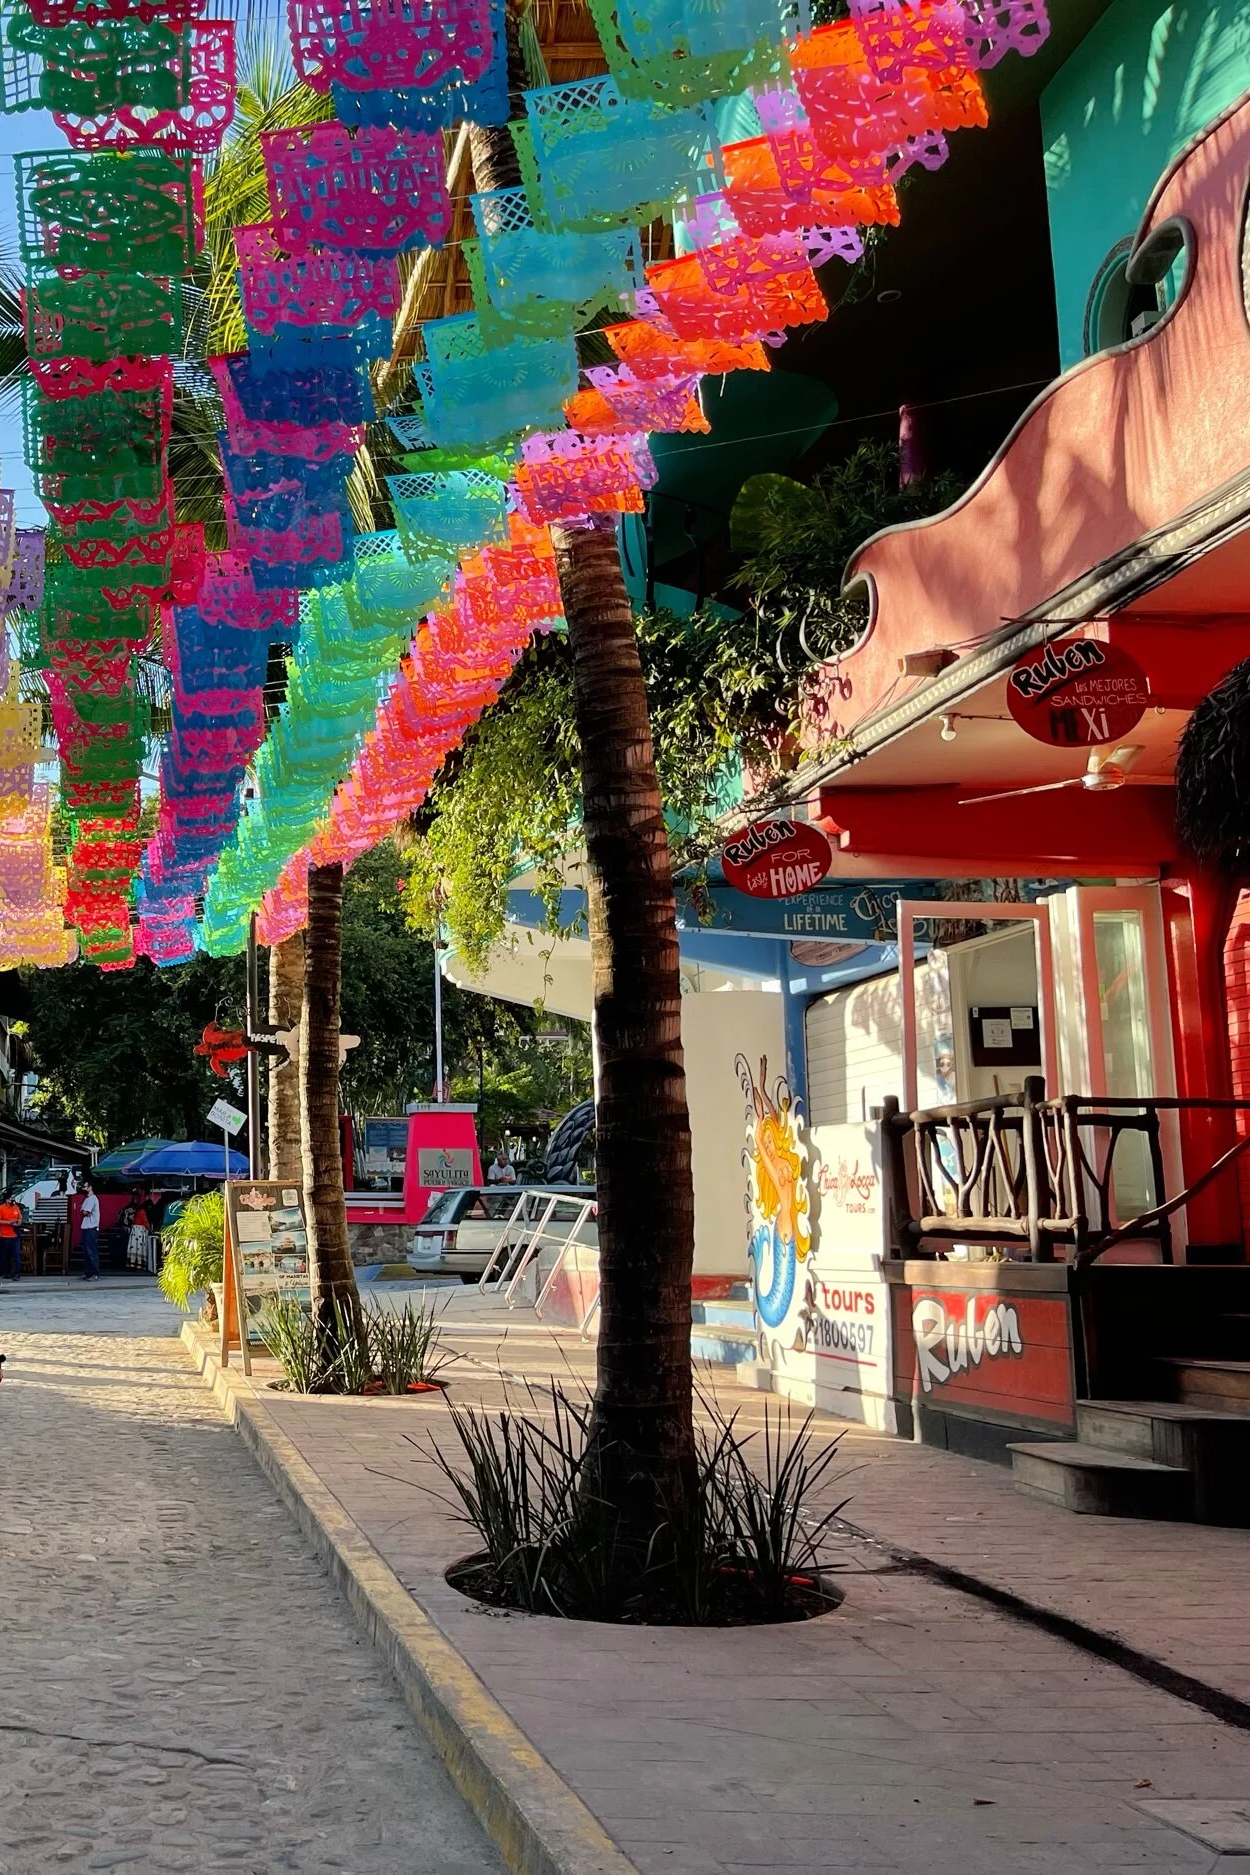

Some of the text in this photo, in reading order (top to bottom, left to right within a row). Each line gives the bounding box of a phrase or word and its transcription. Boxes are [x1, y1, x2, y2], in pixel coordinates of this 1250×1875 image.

[1010, 640, 1106, 698] Ruben
[1089, 678, 1138, 693] MEJORES
[1050, 693, 1148, 707] SANDWICHES
[724, 819, 797, 867] Ruben
[771, 848, 812, 864] FOR
[769, 861, 823, 897] HOME
[784, 894, 844, 906] EXPERIENCE
[783, 914, 849, 931] LIFETIME
[821, 1281, 875, 1315] tours
[911, 1297, 1022, 1393] Ruben
